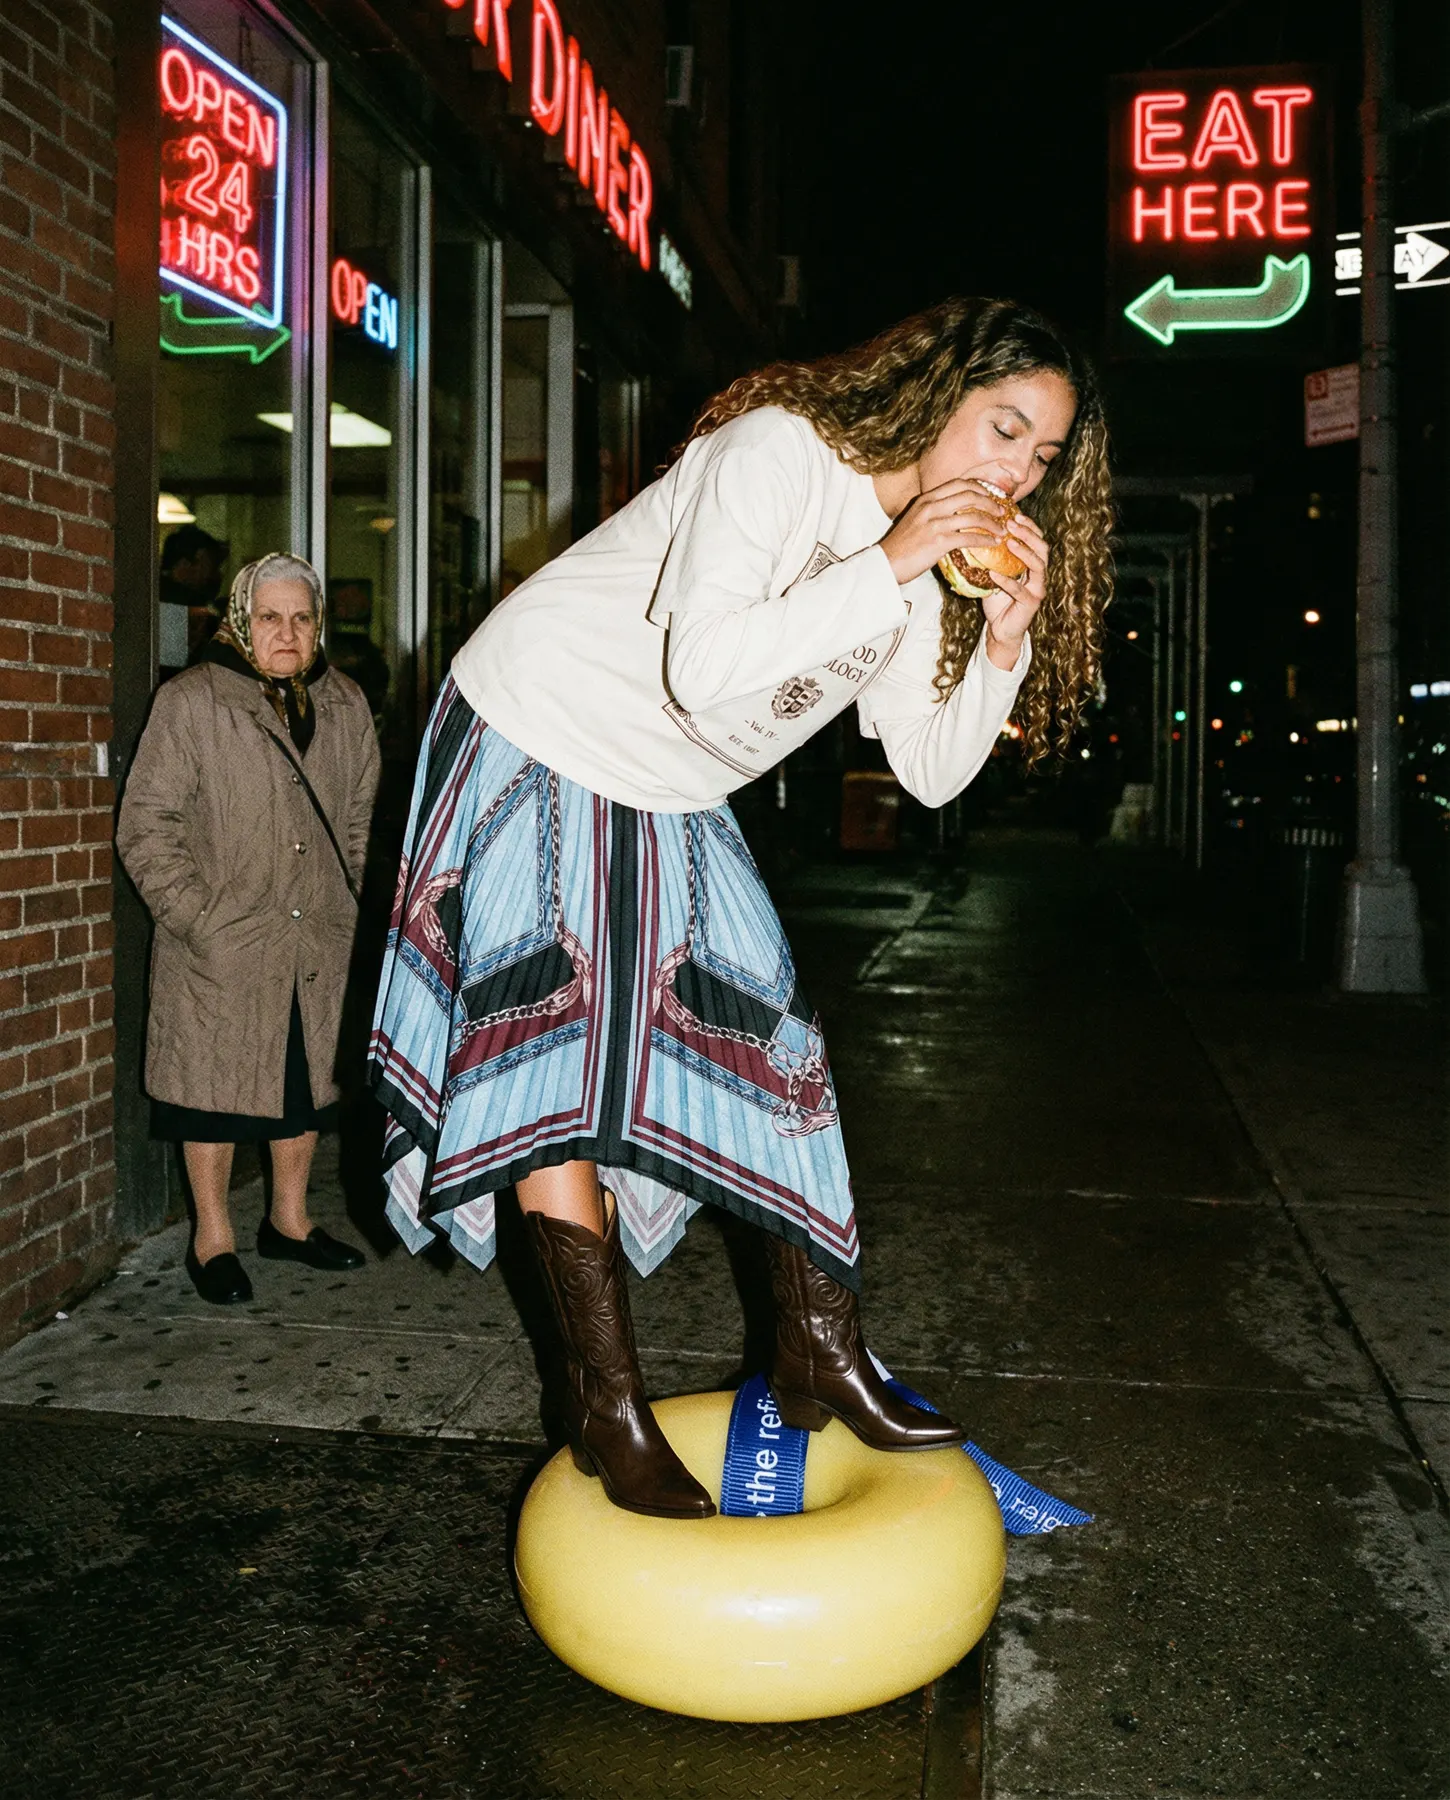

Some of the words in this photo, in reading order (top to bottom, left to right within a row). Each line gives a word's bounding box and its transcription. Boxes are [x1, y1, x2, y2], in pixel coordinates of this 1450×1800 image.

[160, 49, 275, 166] OPEN
[530, 0, 652, 271] DINER
[1133, 86, 1312, 171] EAT
[184, 135, 252, 233] 24
[1133, 181, 1311, 241] HERE
[177, 216, 260, 299] HRS
[1401, 246, 1431, 267] AY
[332, 259, 398, 349] OPEN
[852, 645, 877, 664] OD
[757, 1391, 782, 1440] refi
[745, 1449, 778, 1505] the
